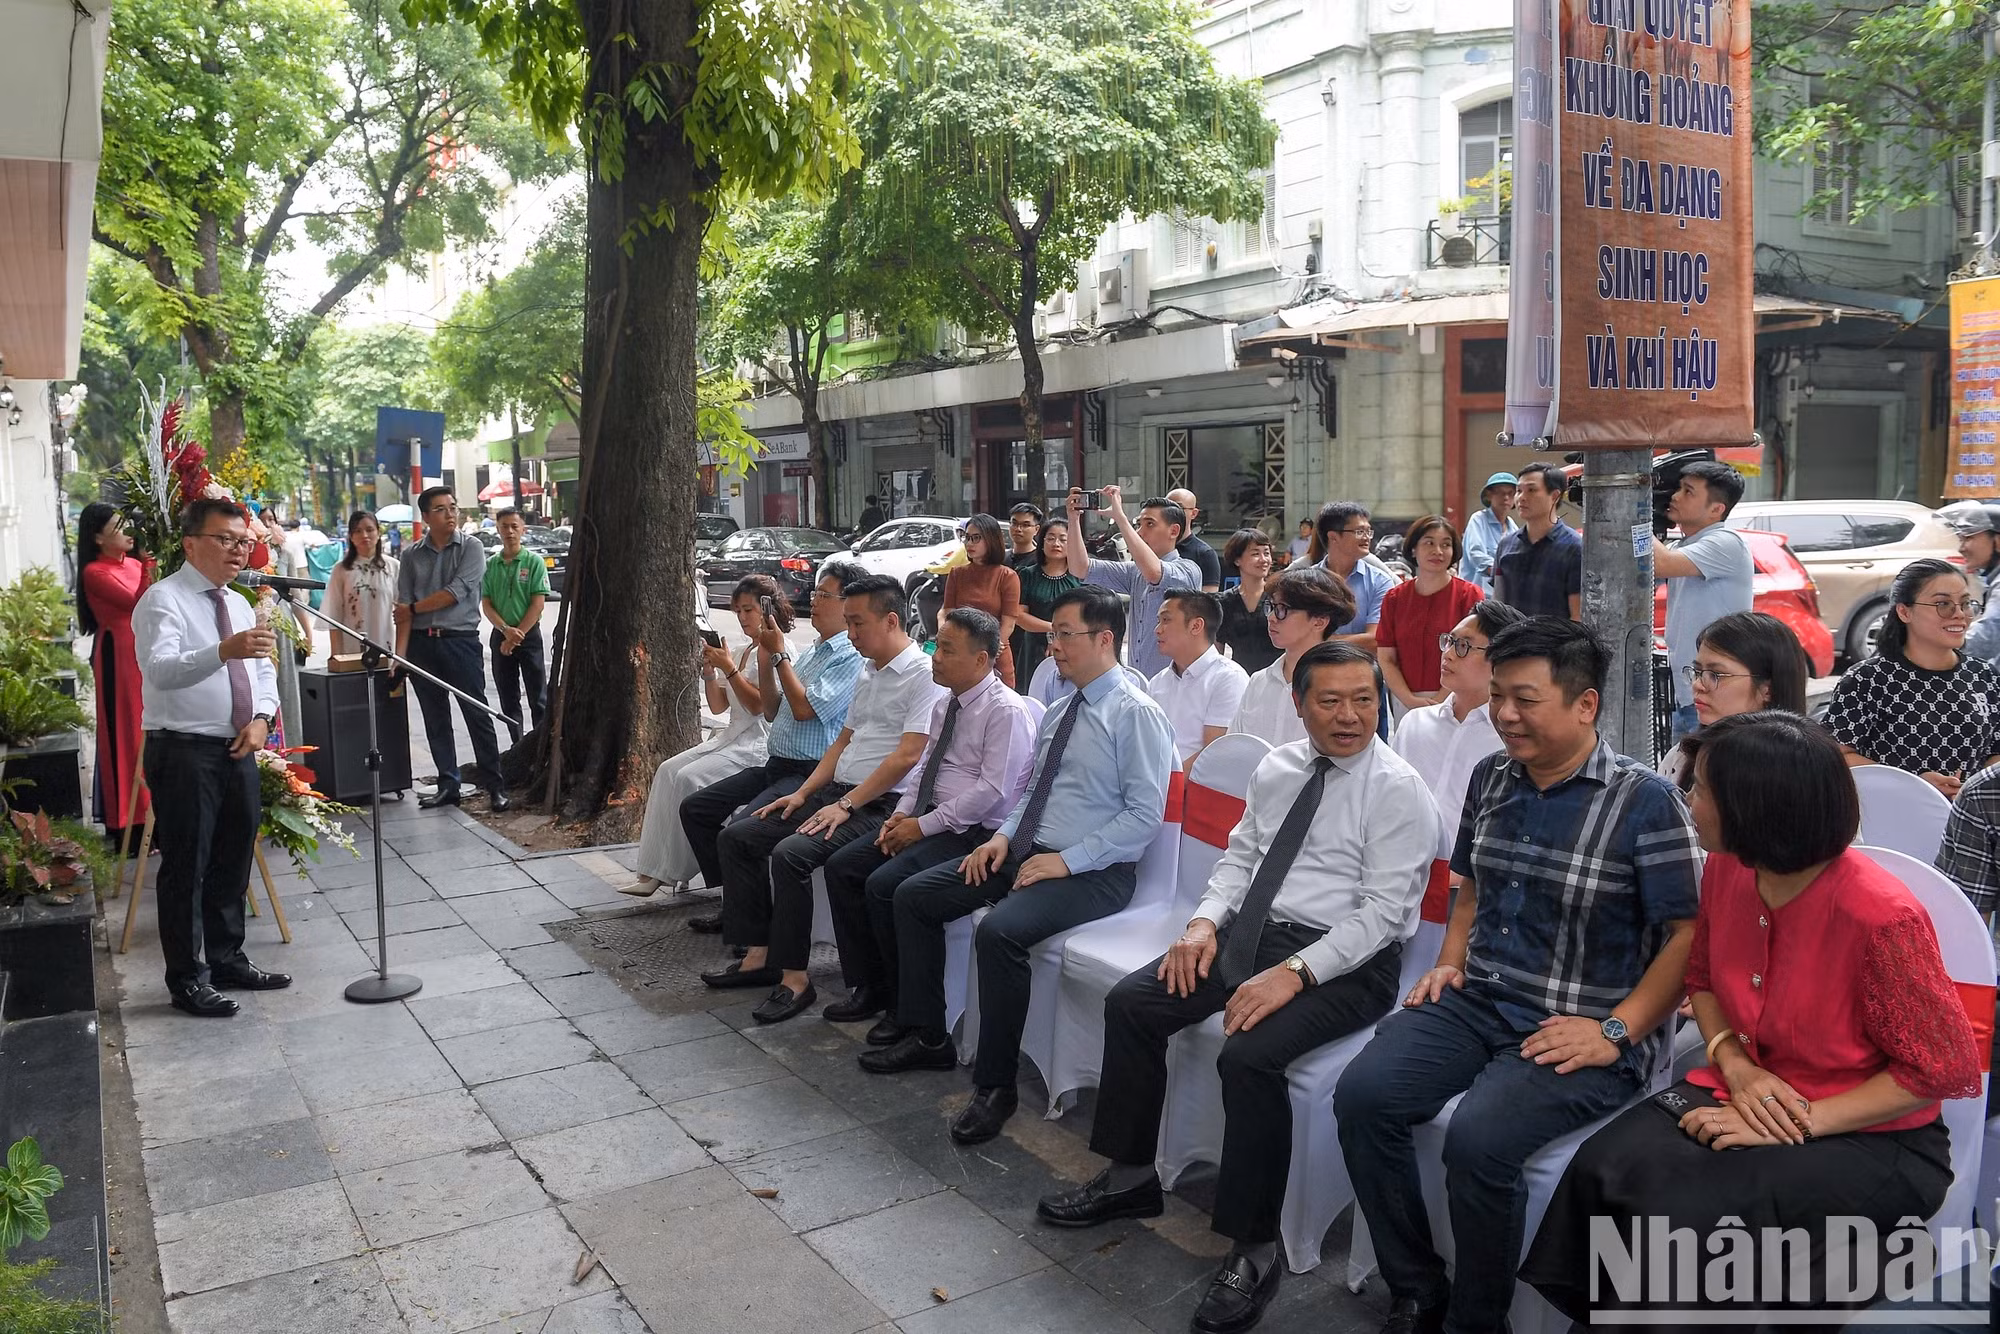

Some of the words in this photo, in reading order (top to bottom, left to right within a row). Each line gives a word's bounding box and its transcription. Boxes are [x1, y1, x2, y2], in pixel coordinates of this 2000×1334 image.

[1565, 45, 1651, 126] KHỦNG
[1658, 63, 1734, 137] HOẢNG
[1582, 137, 1614, 210] VỀ
[1620, 160, 1654, 215] ĐA
[1658, 162, 1722, 230] DẠNG
[1597, 244, 1657, 303] SINH
[1662, 250, 1709, 317] HỌC
[1585, 322, 1619, 390] VÀ
[1626, 326, 1666, 390] KHÍ
[1671, 326, 1718, 402] HẬU
